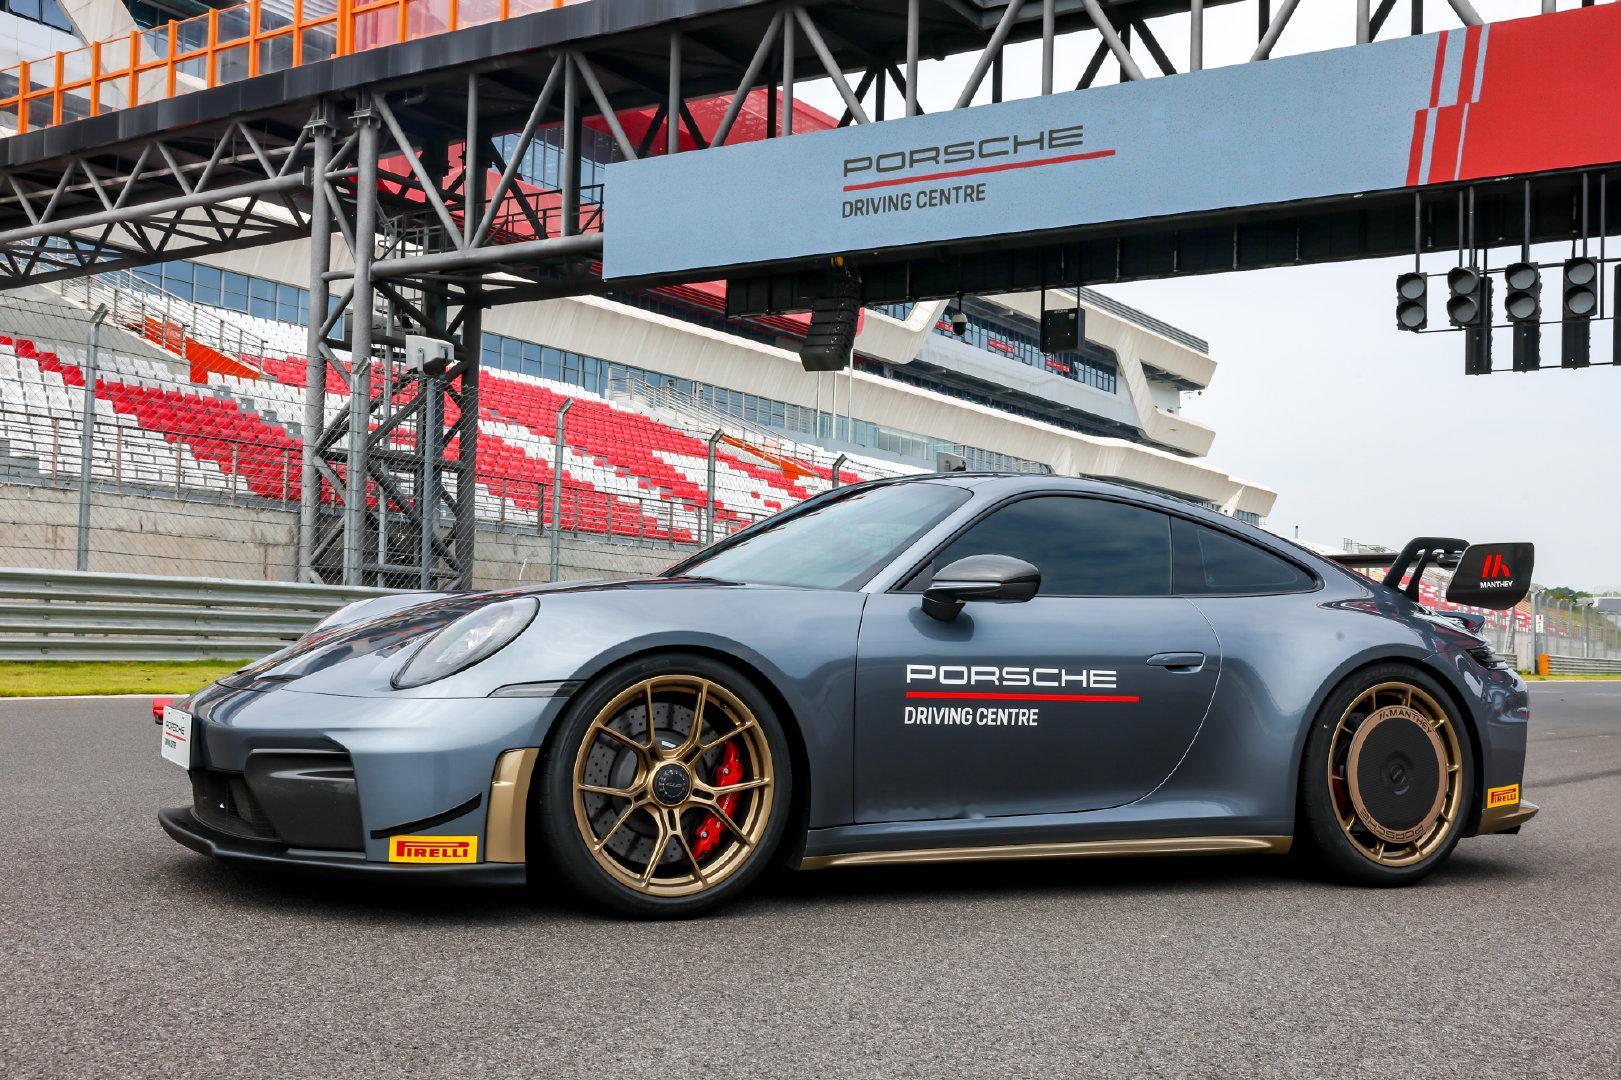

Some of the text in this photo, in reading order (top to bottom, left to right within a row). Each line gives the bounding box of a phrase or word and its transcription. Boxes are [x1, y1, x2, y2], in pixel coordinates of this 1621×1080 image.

[843, 125, 1084, 178] PORSCHE
[842, 183, 987, 219] DRIVING CENTRE
[1480, 580, 1514, 589] MANTHEY
[906, 664, 1117, 689] PORSCHE
[904, 706, 1039, 727] DRIVING CENTRE
[1389, 709, 1432, 733] MANTHEY
[1490, 787, 1517, 804] PIRELLI
[1359, 808, 1424, 840] PORSCHE
[396, 840, 470, 858] PIRELLI
